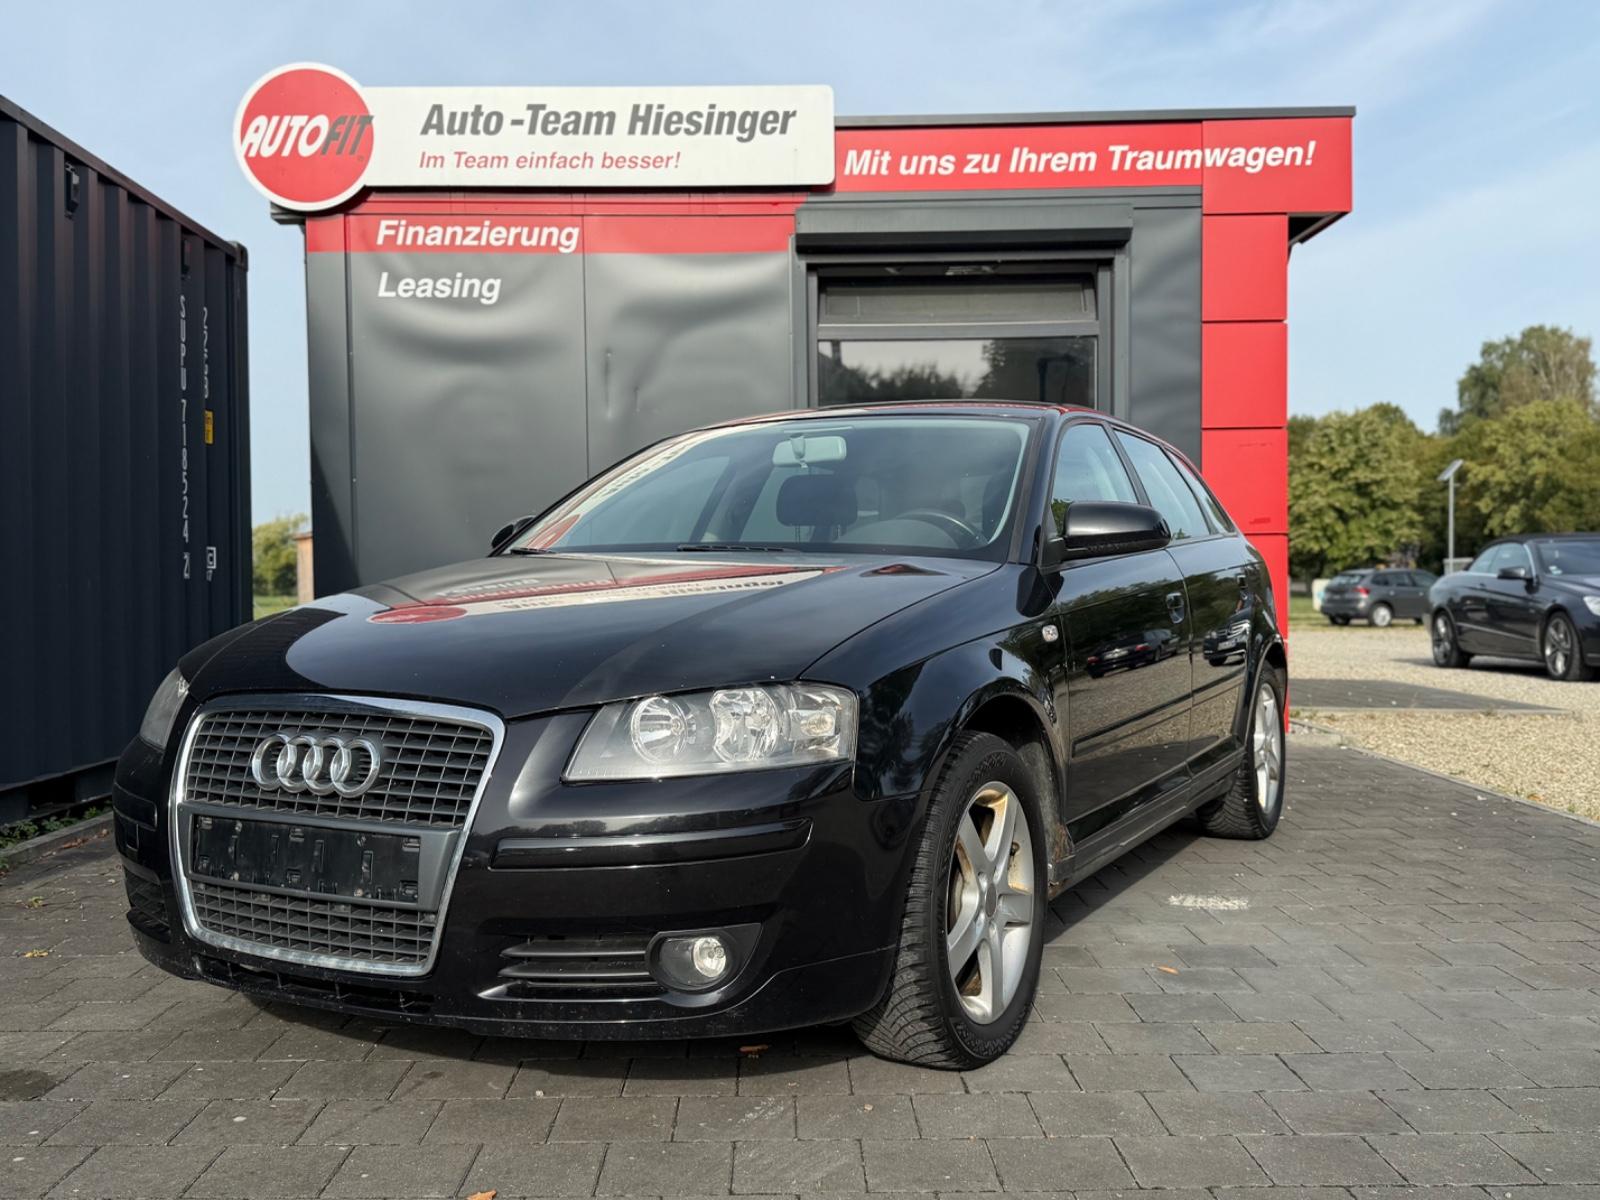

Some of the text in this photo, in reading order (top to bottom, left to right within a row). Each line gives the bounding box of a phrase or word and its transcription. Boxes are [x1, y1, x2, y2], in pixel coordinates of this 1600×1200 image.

[241, 114, 375, 158] AUTOFIT
[420, 103, 505, 136] Auto
[627, 103, 798, 144] Hiesinger
[419, 151, 681, 169] Im Team einfach besser!
[843, 140, 1317, 176] Mit uns zu Ihrem Traumwagen!
[376, 219, 580, 254] Finanzierung
[377, 271, 502, 305] Leasing
